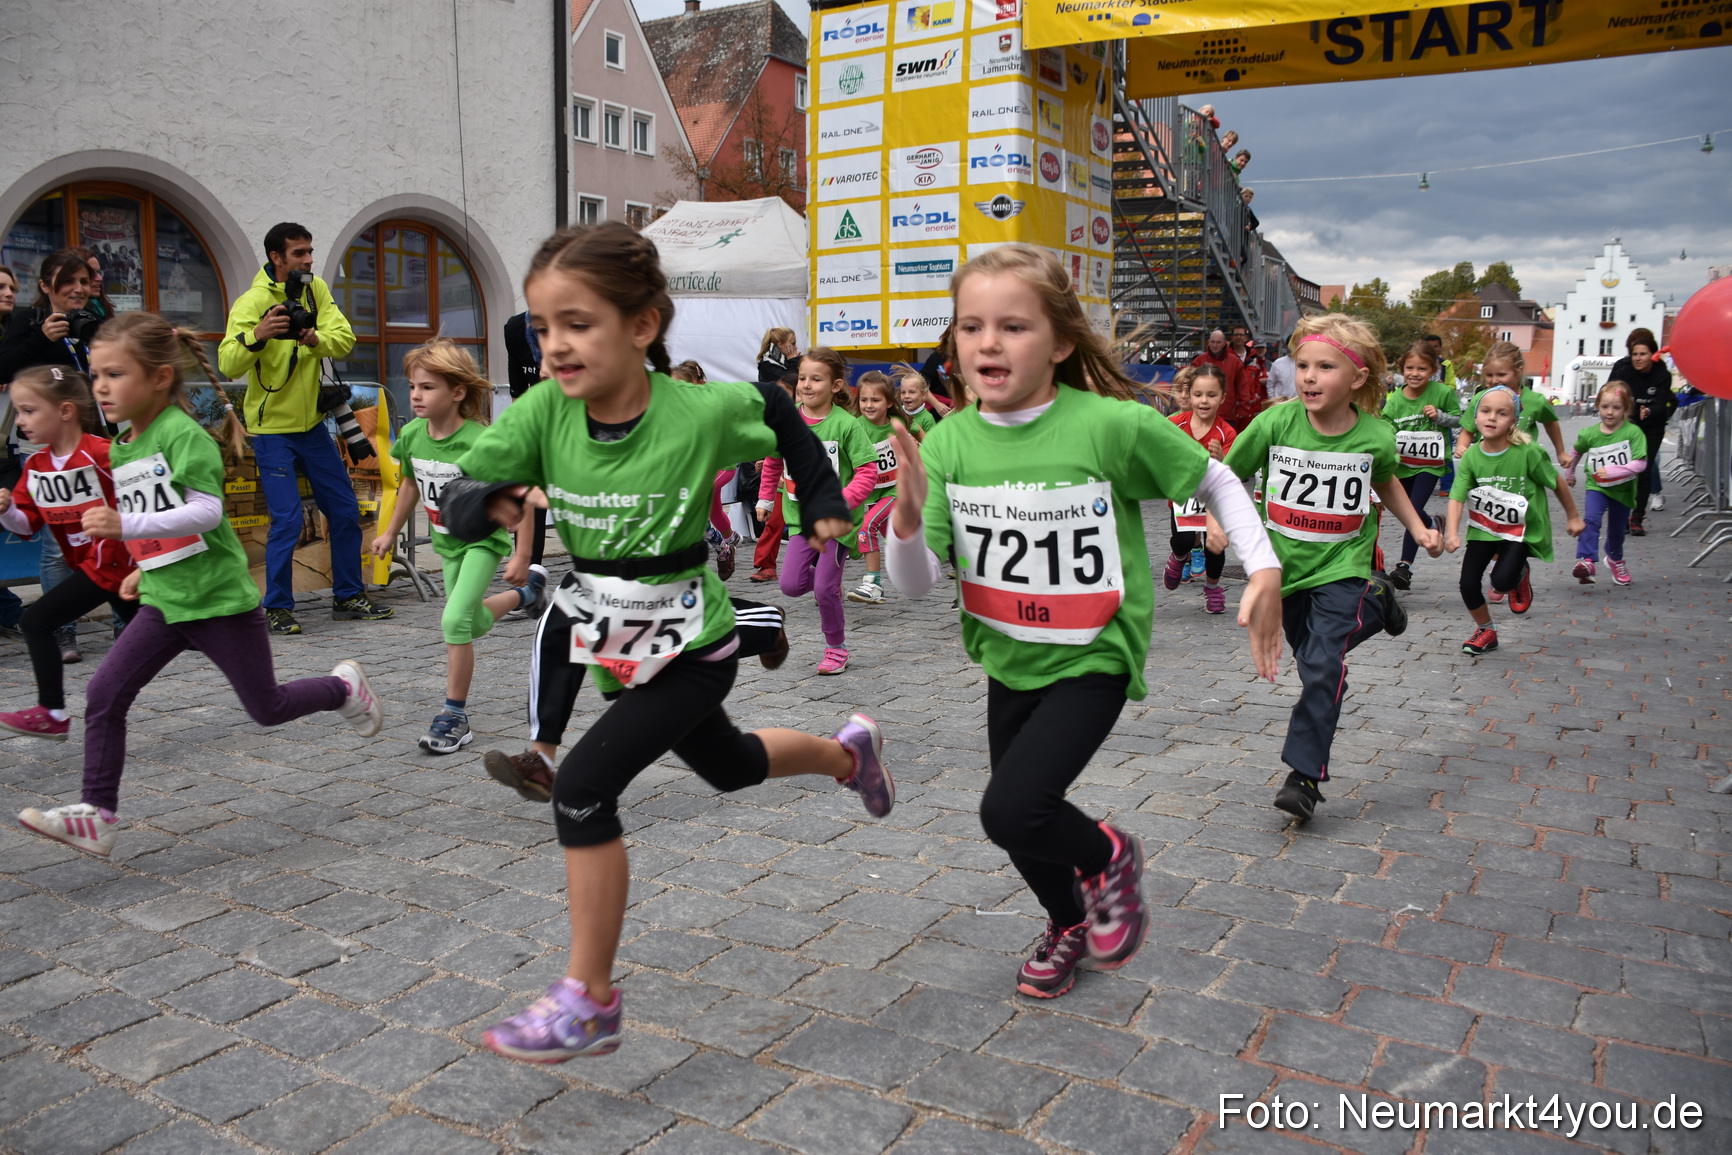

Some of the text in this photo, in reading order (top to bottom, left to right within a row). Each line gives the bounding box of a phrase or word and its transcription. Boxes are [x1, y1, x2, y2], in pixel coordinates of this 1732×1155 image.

[1608, 8, 1703, 28] Neumarkter
[855, 33, 884, 43] energie
[1324, 0, 1563, 65] START
[896, 58, 938, 76] swn
[1157, 50, 1285, 71] Neumarkter Stadtlauf
[836, 171, 878, 184] VARIOTEC
[992, 204, 1011, 212] MINI
[925, 222, 956, 232] energie
[898, 262, 951, 273] Neumarkter Tagblatt
[851, 329, 878, 338] energie
[1397, 442, 1439, 458] 7440
[1272, 453, 1357, 472] PARTL Neumarkt
[1279, 468, 1363, 512] 7219
[952, 499, 1087, 521] PARTL Neumarkt
[1471, 495, 1519, 524] 7420
[241, 518, 259, 526] nicht!
[1285, 512, 1343, 531] Johanna
[965, 525, 1105, 586] 7215
[600, 592, 674, 611] Neumarkt
[1017, 600, 1050, 623] Ida
